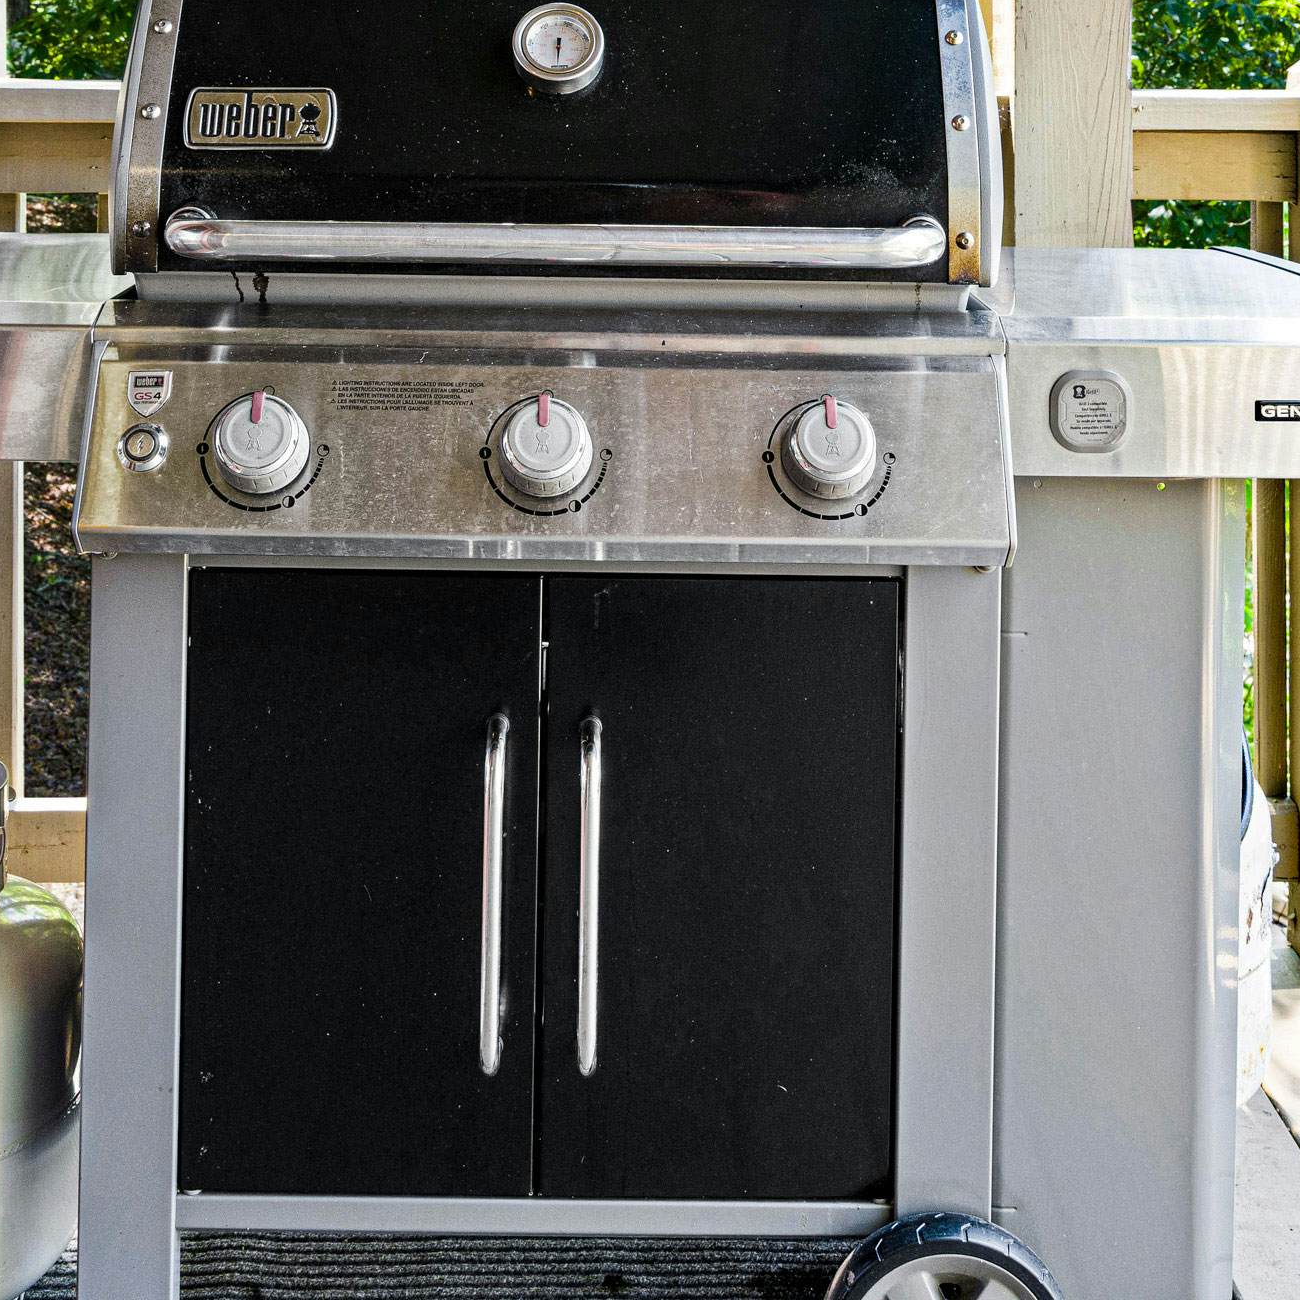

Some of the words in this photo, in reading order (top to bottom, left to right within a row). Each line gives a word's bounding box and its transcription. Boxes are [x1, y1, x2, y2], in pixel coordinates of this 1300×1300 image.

[199, 91, 296, 138] weber
[136, 376, 157, 386] weber
[134, 392, 161, 400] GS4
